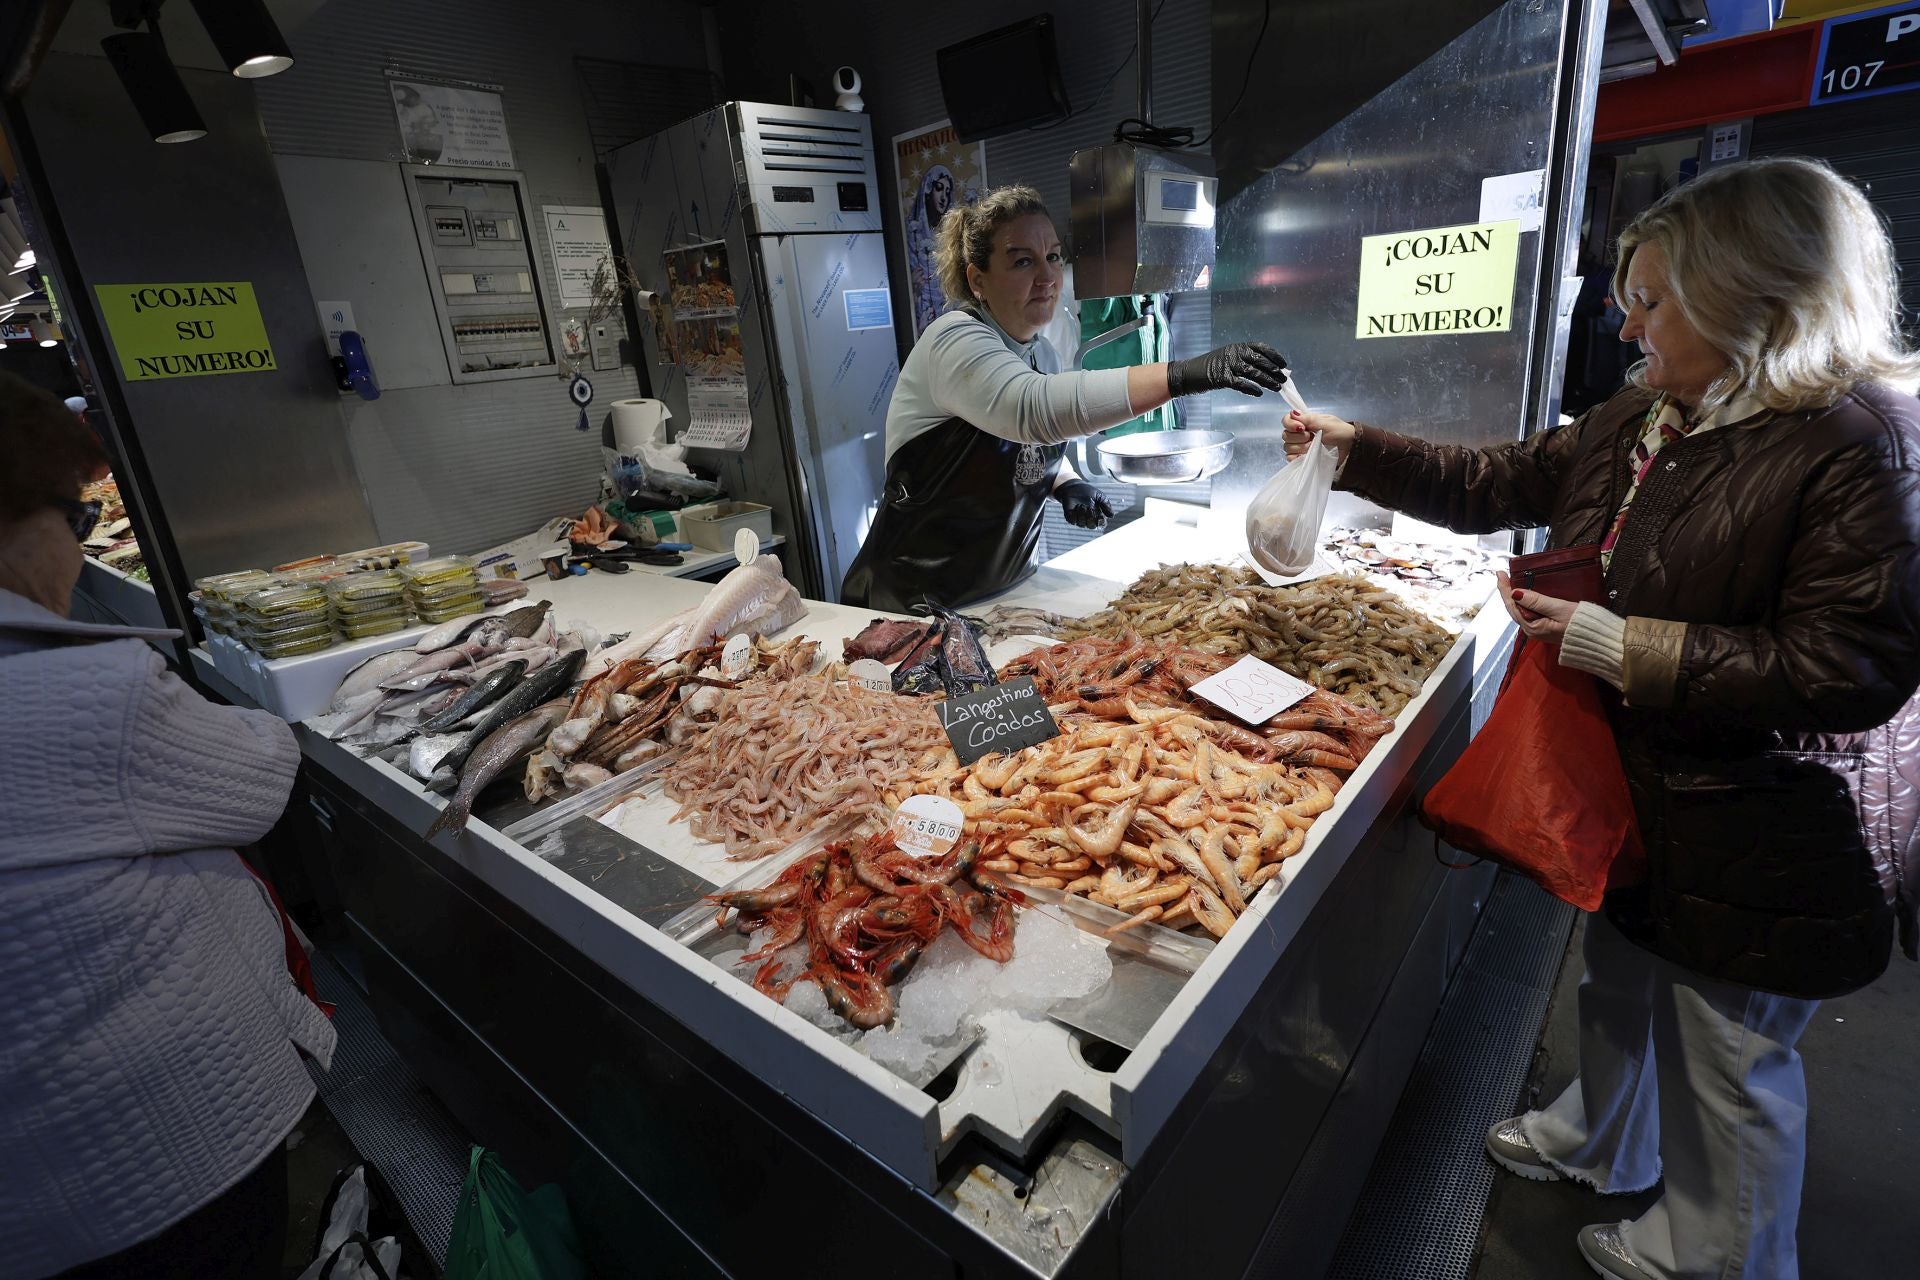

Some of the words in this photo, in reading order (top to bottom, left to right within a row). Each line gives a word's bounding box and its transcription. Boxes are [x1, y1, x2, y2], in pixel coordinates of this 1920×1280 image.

[1823, 60, 1885, 93] 107
[447, 156, 469, 165] Precio
[1386, 229, 1494, 267] ¡COJAN
[1415, 272, 1455, 296] SU
[130, 287, 238, 313] ¡COJAN
[175, 321, 214, 341] SU
[1367, 306, 1503, 335] NUMERO!
[134, 349, 273, 377] NUMERO!
[968, 708, 1045, 748] Cocidos
